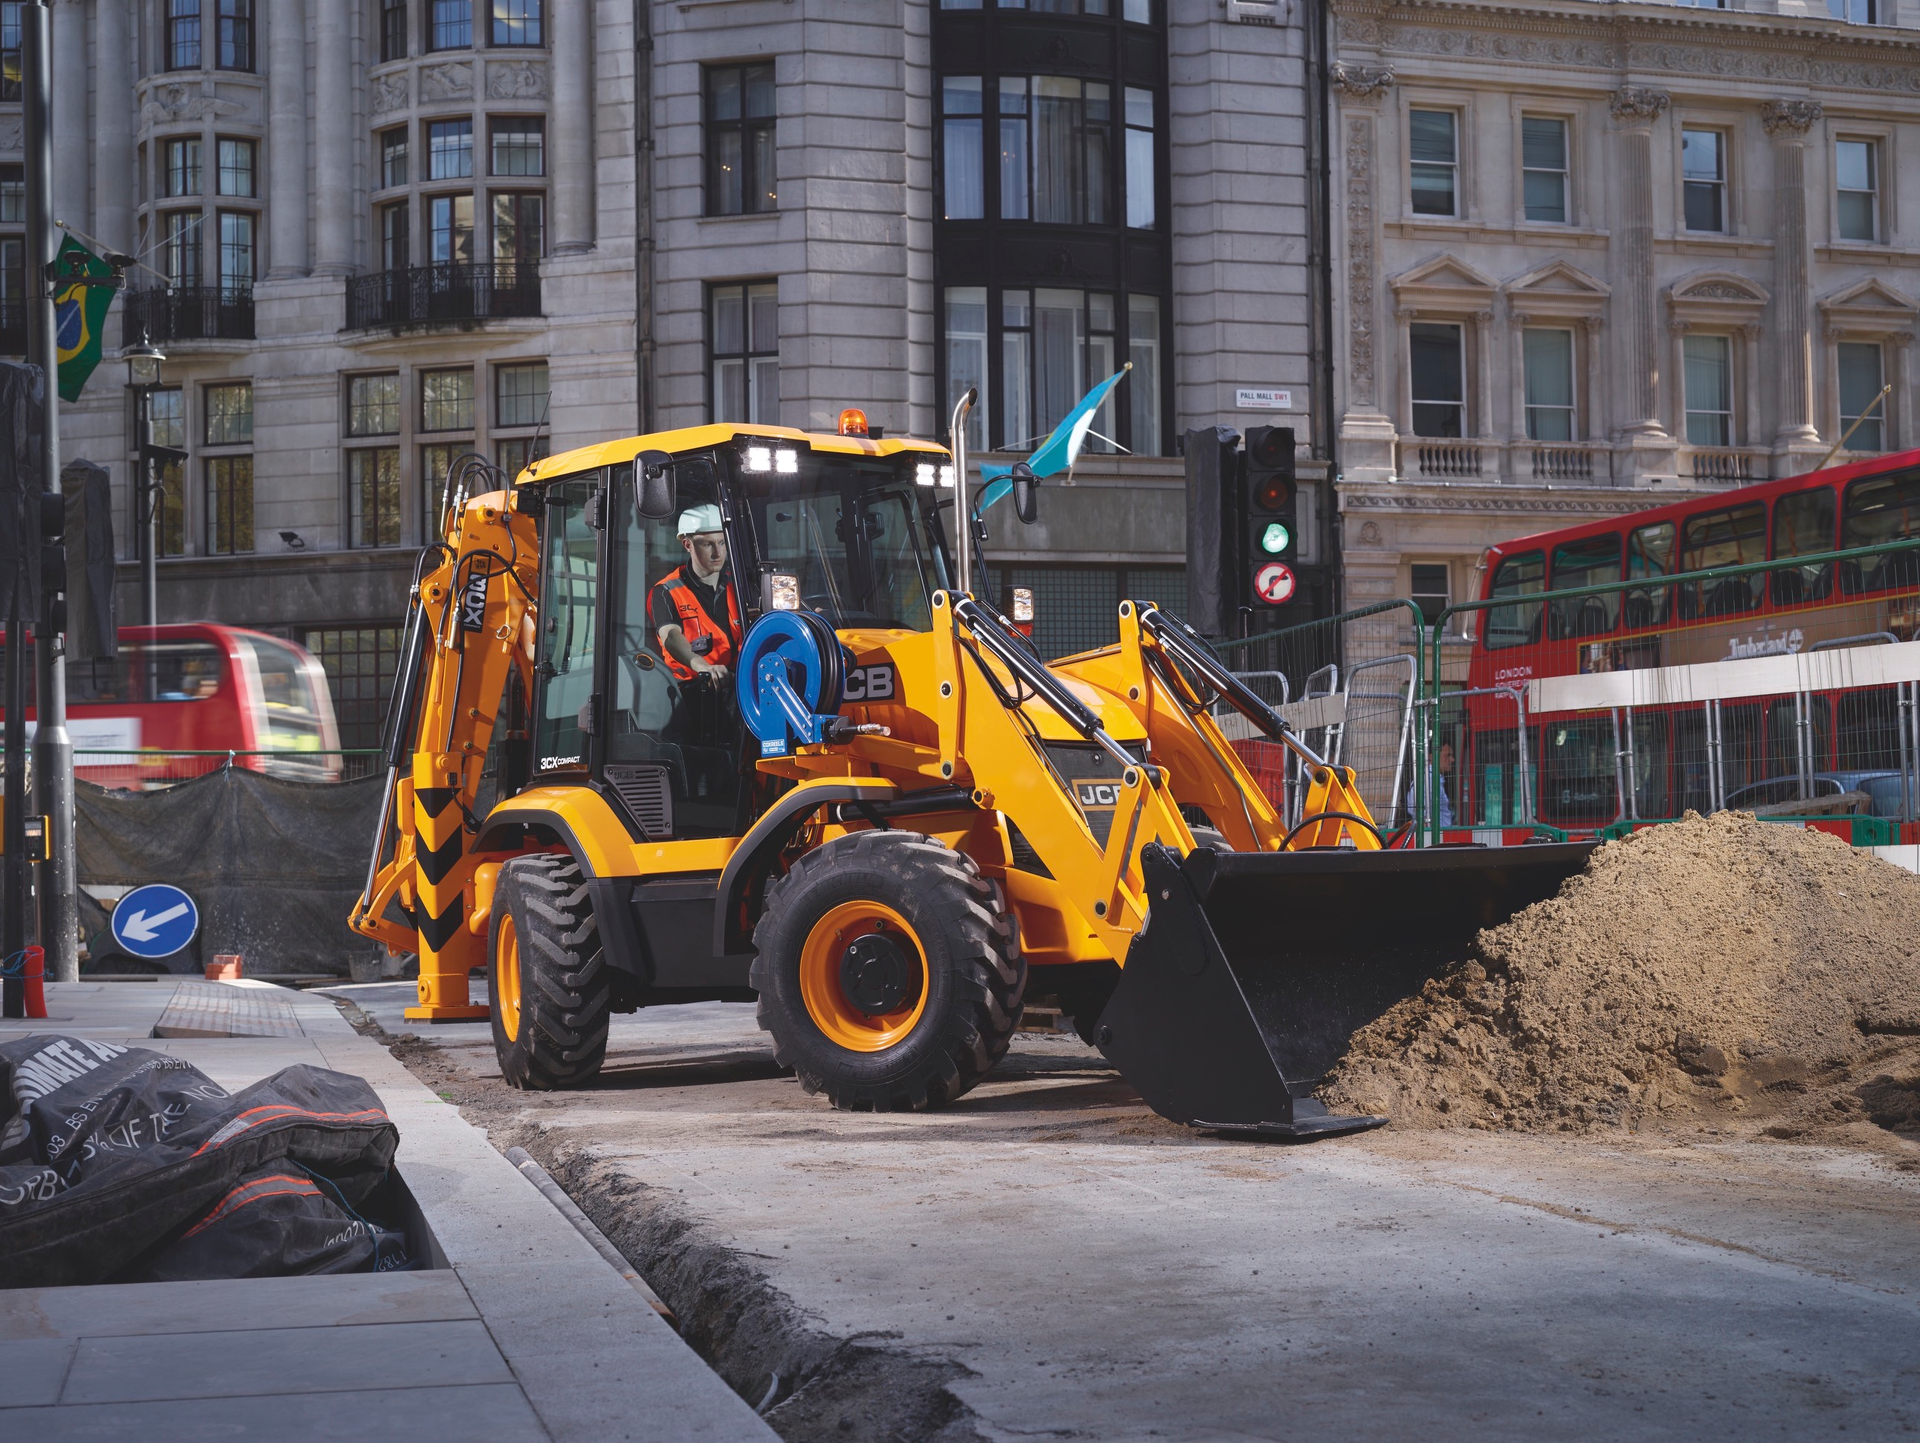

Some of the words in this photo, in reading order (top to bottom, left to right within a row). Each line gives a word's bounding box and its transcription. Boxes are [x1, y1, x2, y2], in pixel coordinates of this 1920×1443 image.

[463, 573, 487, 626] 3CX
[1495, 666, 1532, 680] LONDON
[843, 666, 893, 700] CB
[540, 756, 559, 770] 3CX
[557, 755, 581, 765] COMPACT
[613, 770, 634, 780] JCB
[65, 1112, 88, 1131] BS
